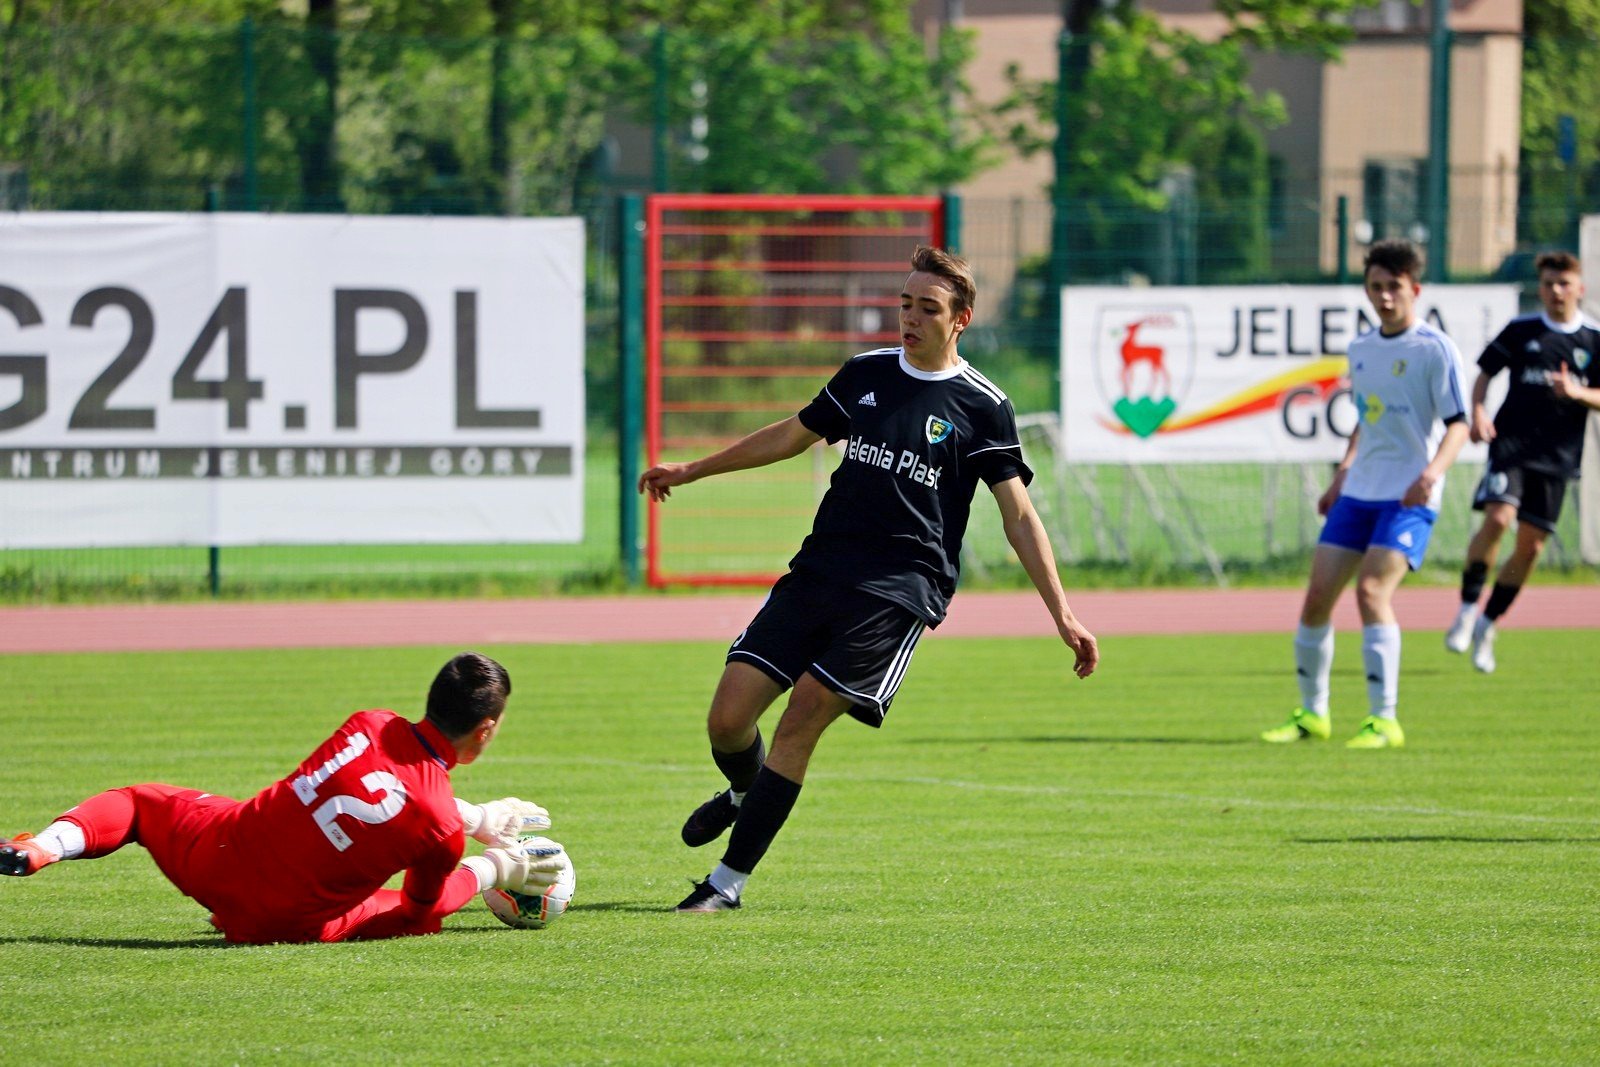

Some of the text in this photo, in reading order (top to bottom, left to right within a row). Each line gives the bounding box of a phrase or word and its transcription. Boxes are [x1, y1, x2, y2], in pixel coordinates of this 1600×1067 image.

[1216, 307, 1446, 357] JELE
[193, 448, 402, 477] JELENIEJ
[430, 446, 544, 476] GÓRY
[896, 449, 943, 490] Plast
[292, 731, 407, 852] 12
